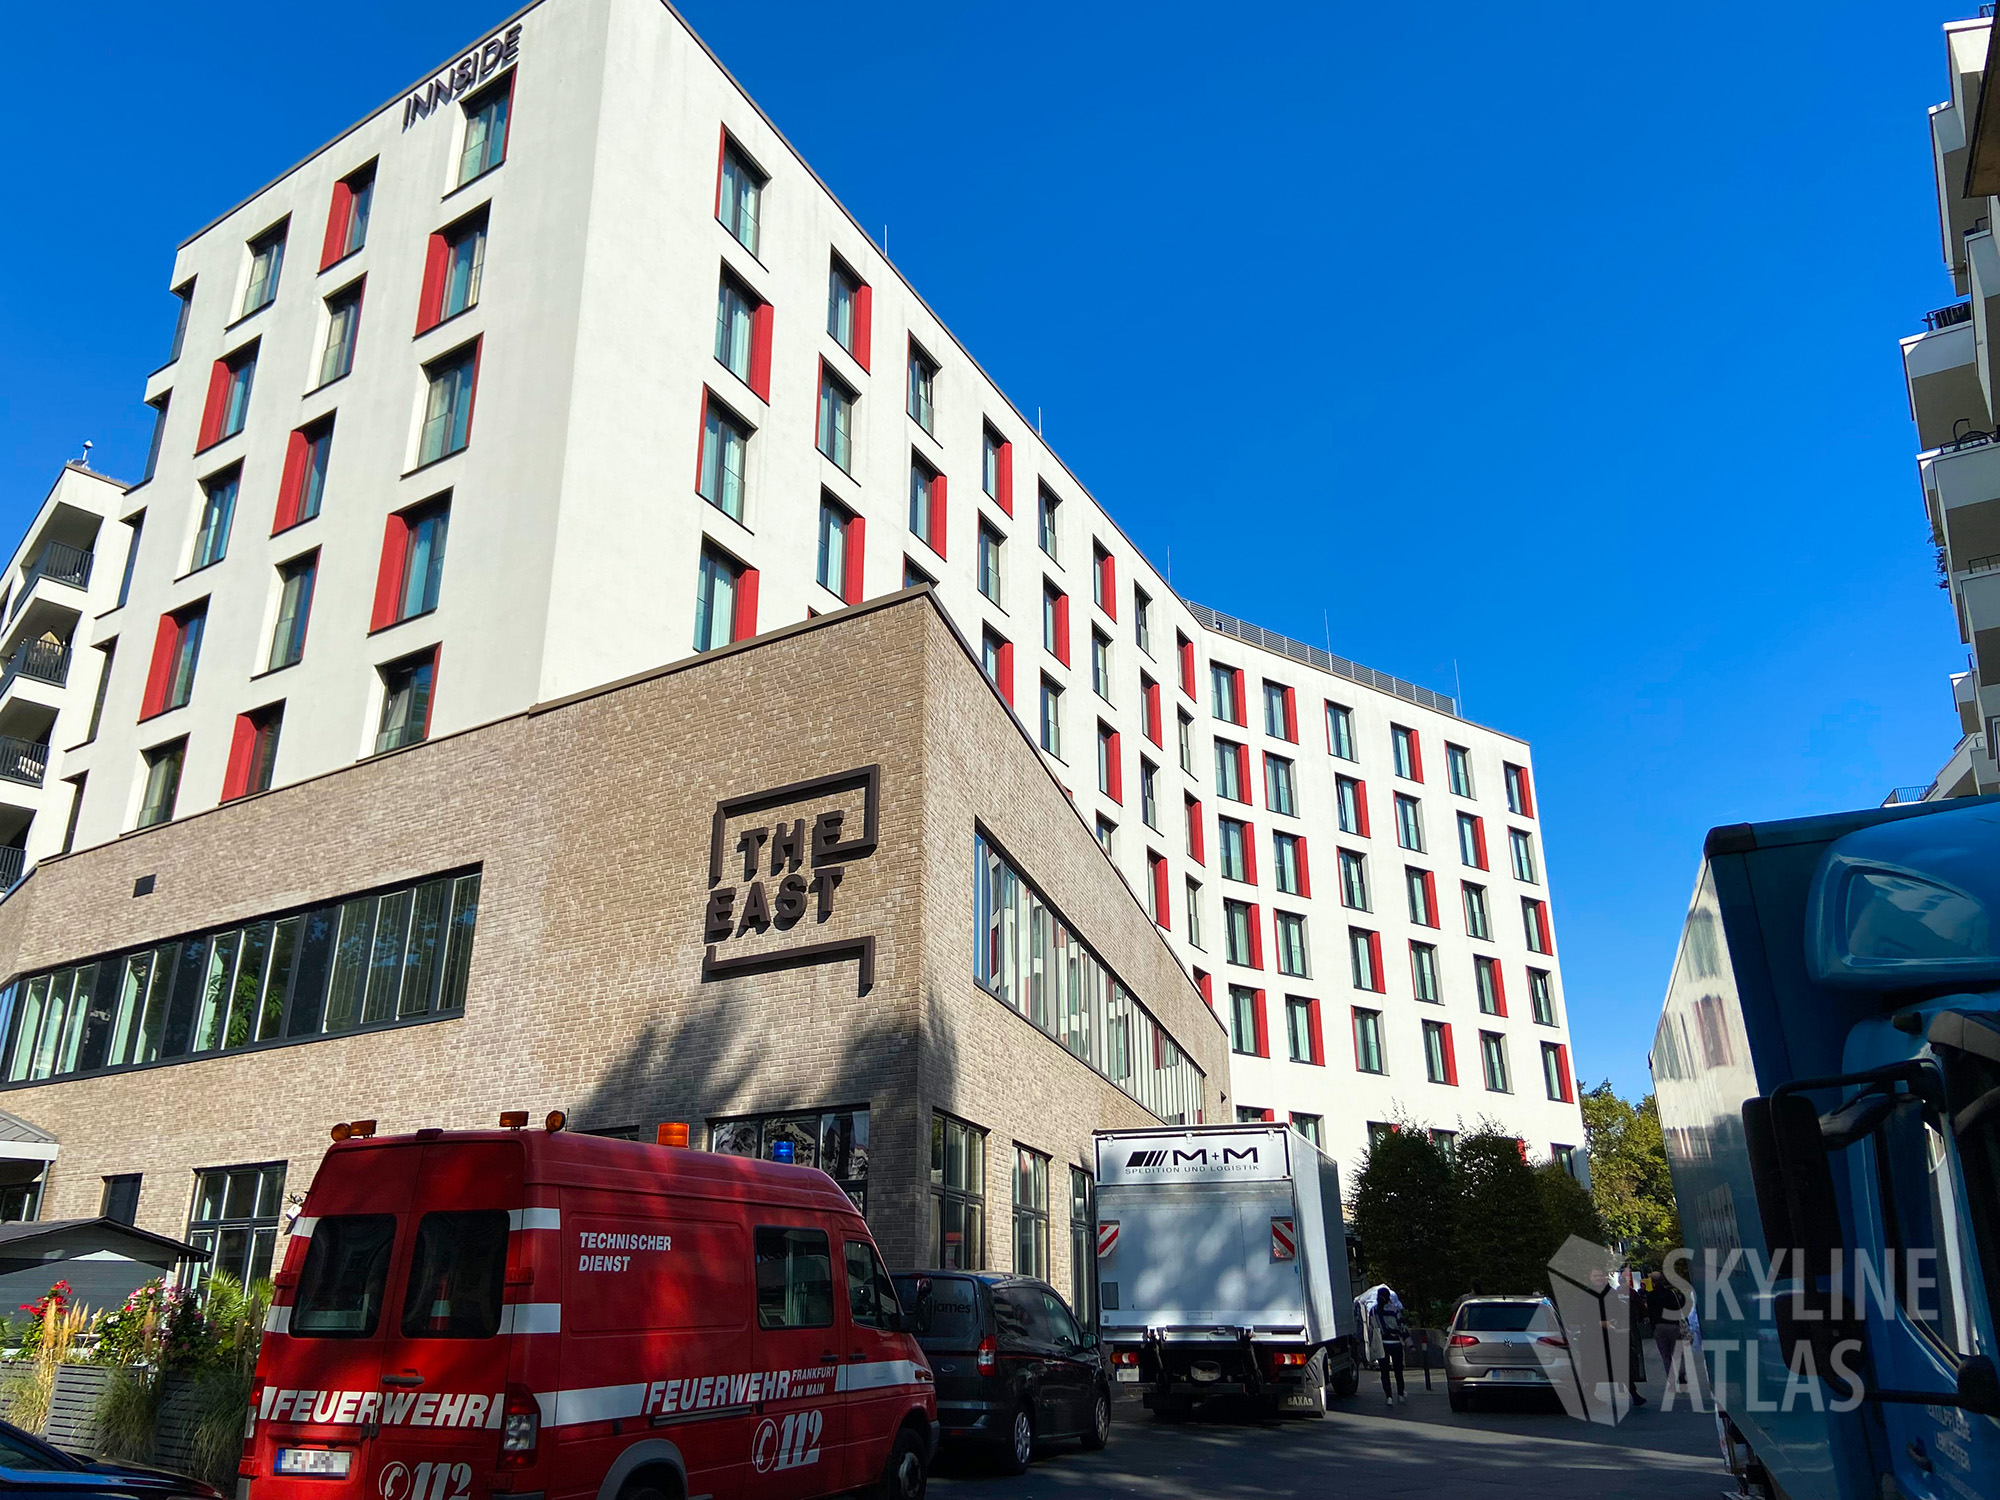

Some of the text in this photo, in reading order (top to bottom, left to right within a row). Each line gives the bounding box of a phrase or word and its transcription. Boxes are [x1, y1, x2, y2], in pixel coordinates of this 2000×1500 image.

[402, 23, 522, 131] INNSIDE
[738, 810, 844, 881] THE
[704, 866, 845, 943] EAST
[1125, 1164, 1259, 1175] SPEDITION UND LOGISTIK
[580, 1231, 671, 1251] TECHNISCHER
[579, 1255, 631, 1272] DIENST
[645, 1370, 791, 1414] FEUERWEHR
[791, 1366, 836, 1382] FRANKFURT
[791, 1383, 825, 1398] AM MAIN
[270, 1389, 489, 1428] FEUERWEHR
[773, 1409, 823, 1472] 112
[410, 1461, 472, 1500] 112
